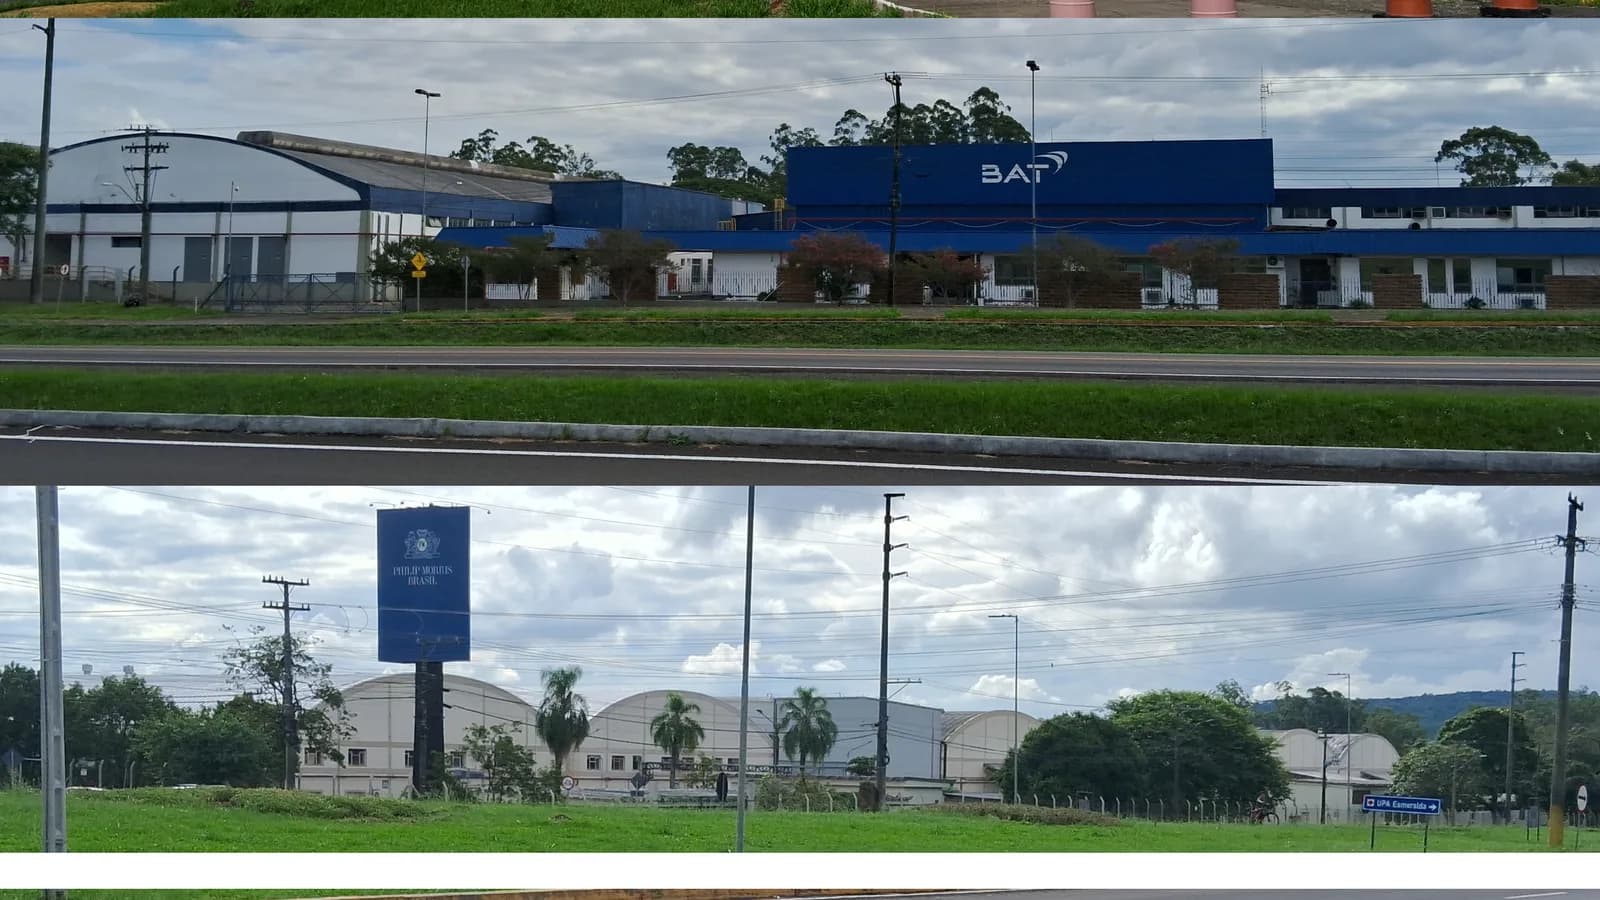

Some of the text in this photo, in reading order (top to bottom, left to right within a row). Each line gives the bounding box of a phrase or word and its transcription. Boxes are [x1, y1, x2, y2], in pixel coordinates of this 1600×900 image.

[981, 163, 1050, 184] BAT
[393, 565, 453, 576] PHILIP MORRIS
[408, 575, 438, 585] BRASIL
[1376, 799, 1427, 810] UPA Esmeralda
